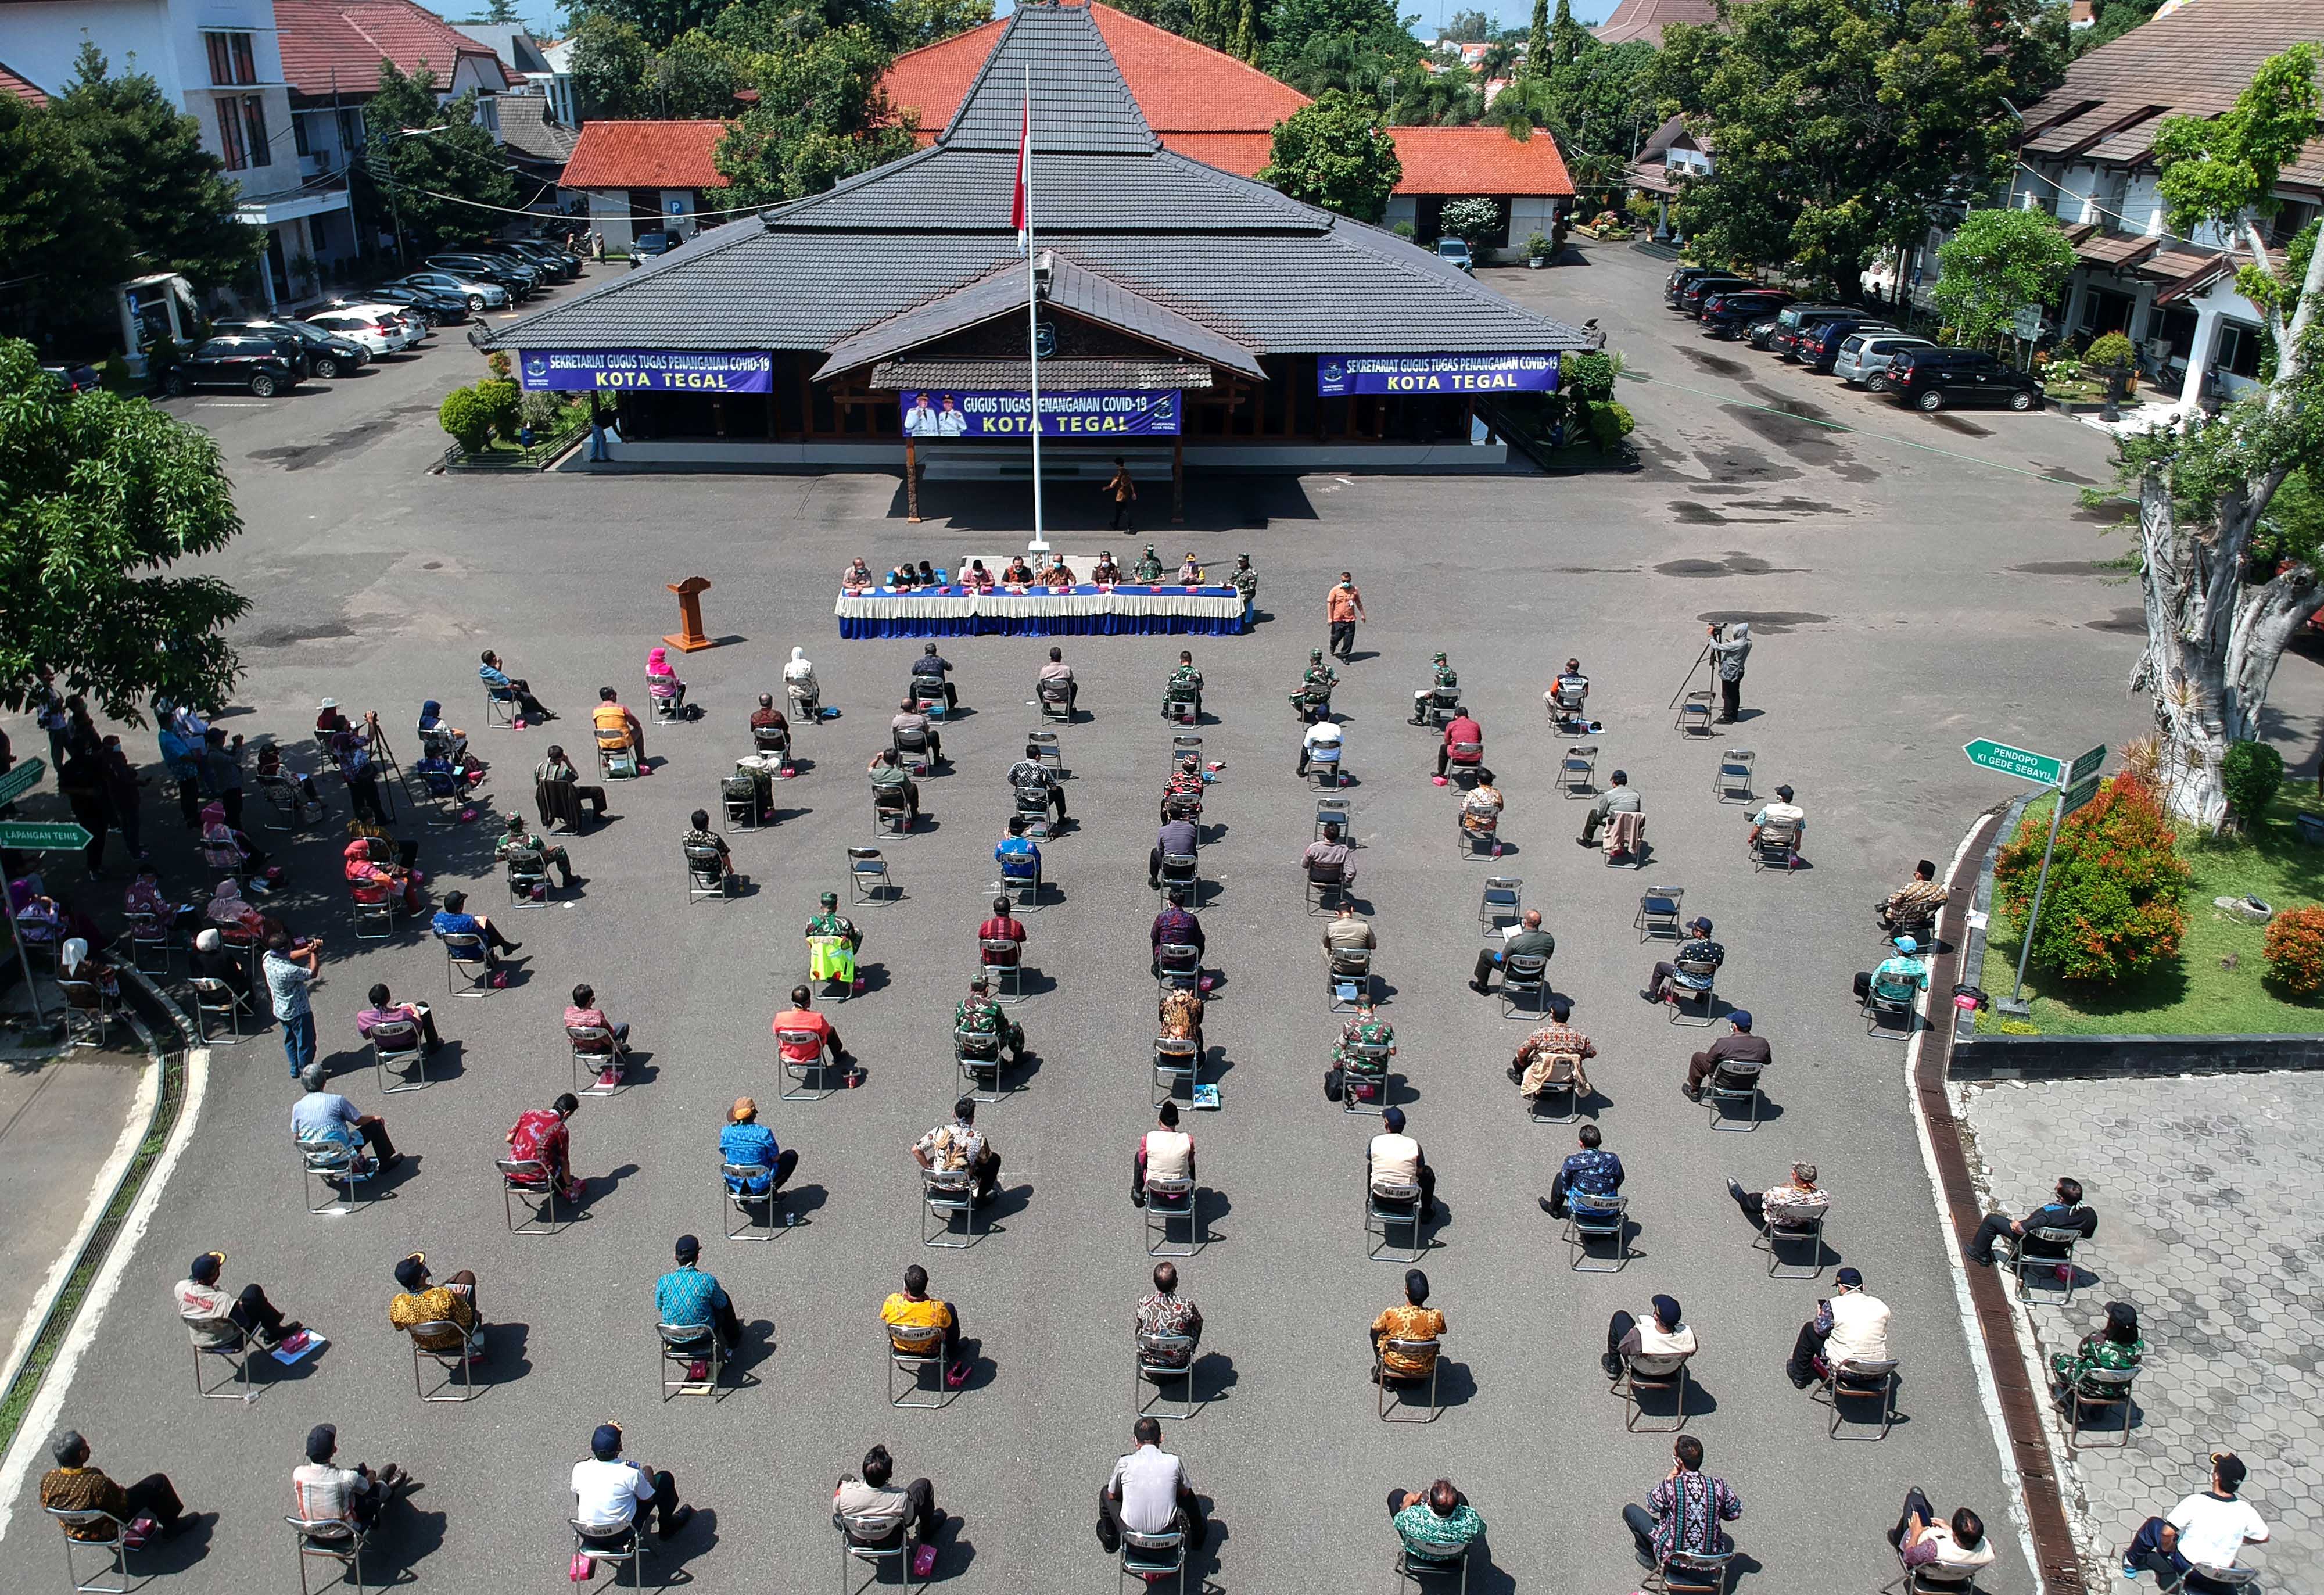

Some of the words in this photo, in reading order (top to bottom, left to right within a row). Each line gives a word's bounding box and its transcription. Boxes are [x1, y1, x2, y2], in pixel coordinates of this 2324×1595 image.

[550, 354, 605, 369] SEKRETARIAT
[607, 354, 637, 369] GUGUS
[639, 355, 666, 370] TUGAS
[669, 356, 729, 371] PENANGANAN
[730, 357, 770, 371] COVID-19
[1346, 359, 1399, 374] SEKRETARIAT
[1400, 359, 1430, 372] GUGUS
[1432, 358, 1458, 372] TUGAS
[1460, 356, 1518, 371] PENANGANAN
[1520, 356, 1558, 370] COVID-19
[596, 371, 651, 386] KOTA
[662, 372, 728, 388] TEGAL
[1387, 375, 1440, 390] KOTA
[1452, 374, 1517, 389] TEGAL
[963, 397, 997, 413] GUGUS
[999, 397, 1031, 413] TUGAS
[1037, 397, 1100, 413] ENANGANAN
[1102, 396, 1147, 413] COVID-19
[982, 417, 1043, 432] KOTA
[1056, 416, 1129, 432] TEGAL
[1993, 747, 2038, 766] PENDOPO
[1977, 752, 1986, 762] KI
[1988, 757, 2013, 770] GEDE
[2015, 763, 2052, 780] SEBAYU
[5, 830, 51, 841] LAPANGAN
[52, 831, 79, 841] TENIS
